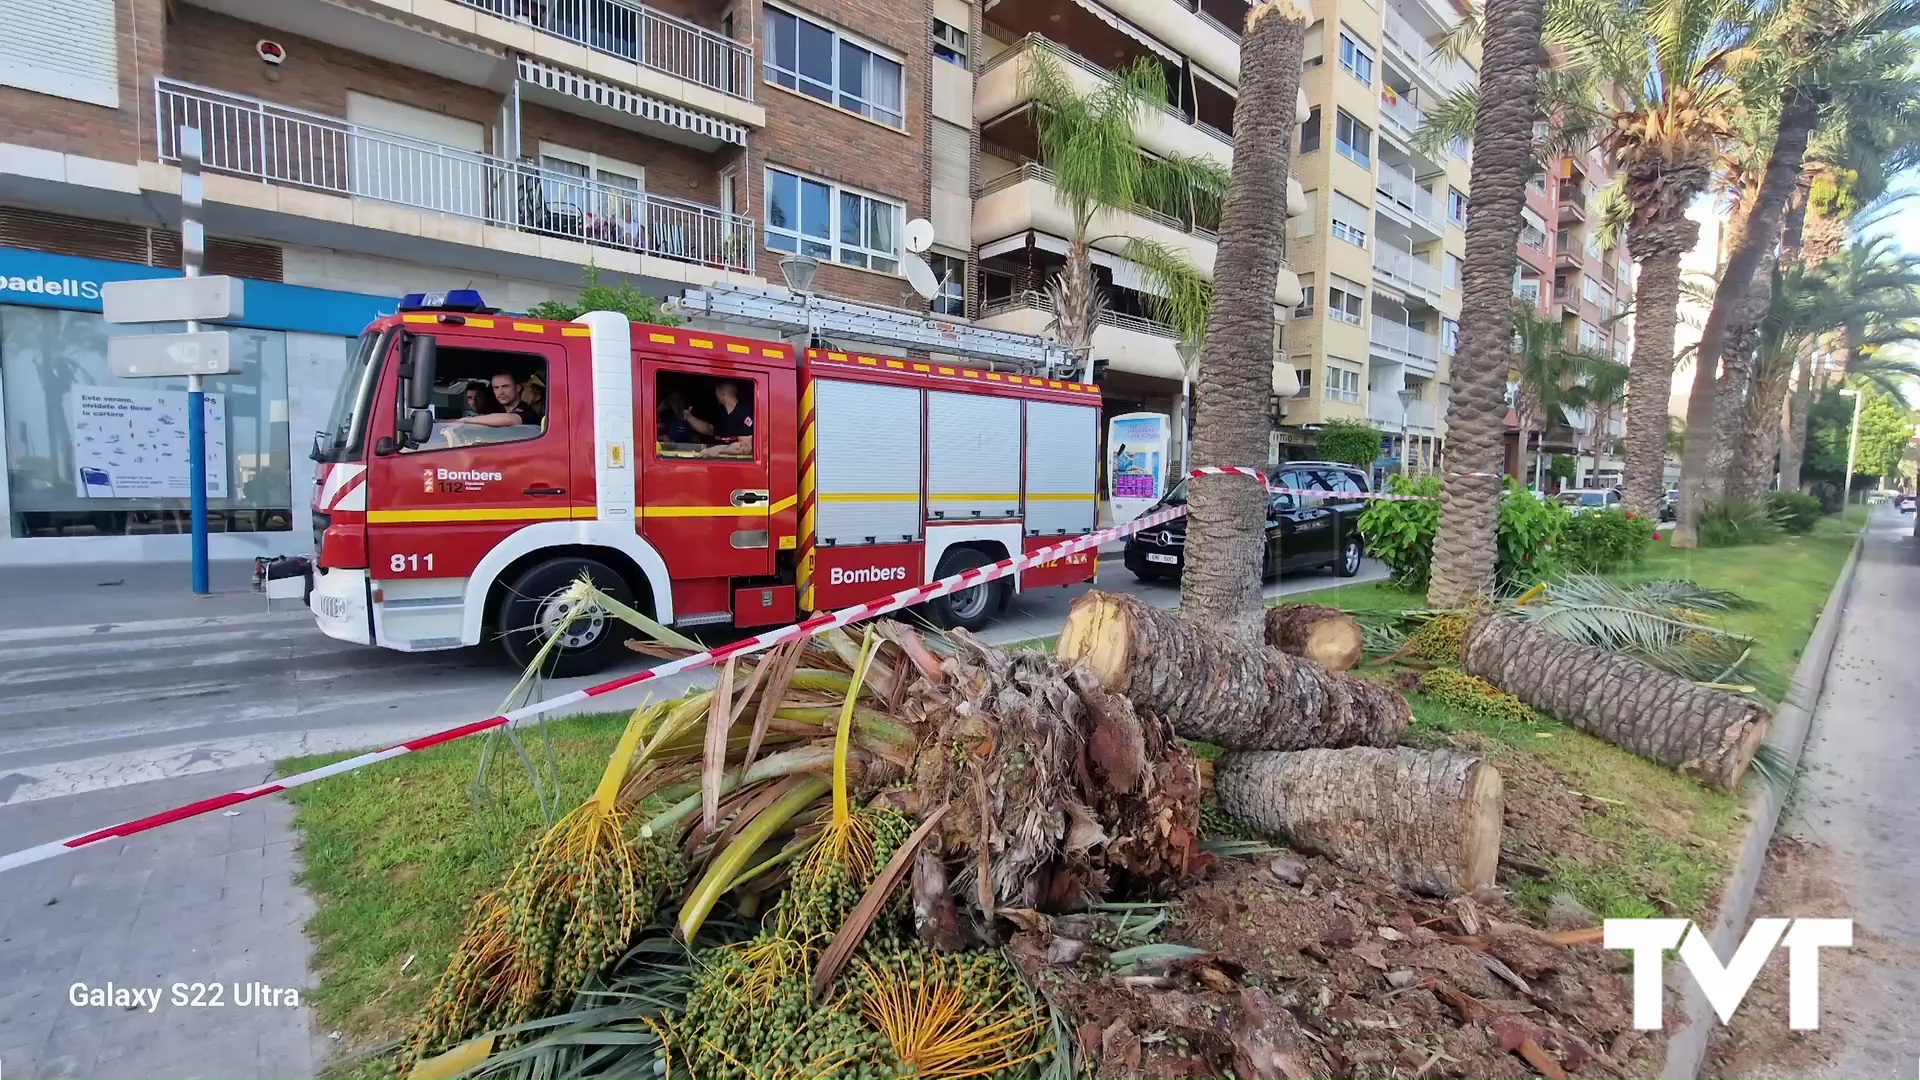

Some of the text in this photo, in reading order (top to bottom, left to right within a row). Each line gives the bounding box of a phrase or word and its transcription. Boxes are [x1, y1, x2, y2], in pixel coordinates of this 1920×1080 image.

[0, 275, 104, 300] adellS
[437, 468, 503, 481] Bombers
[438, 481, 463, 493] 112
[390, 553, 433, 572] 811
[830, 565, 906, 585] Bombers
